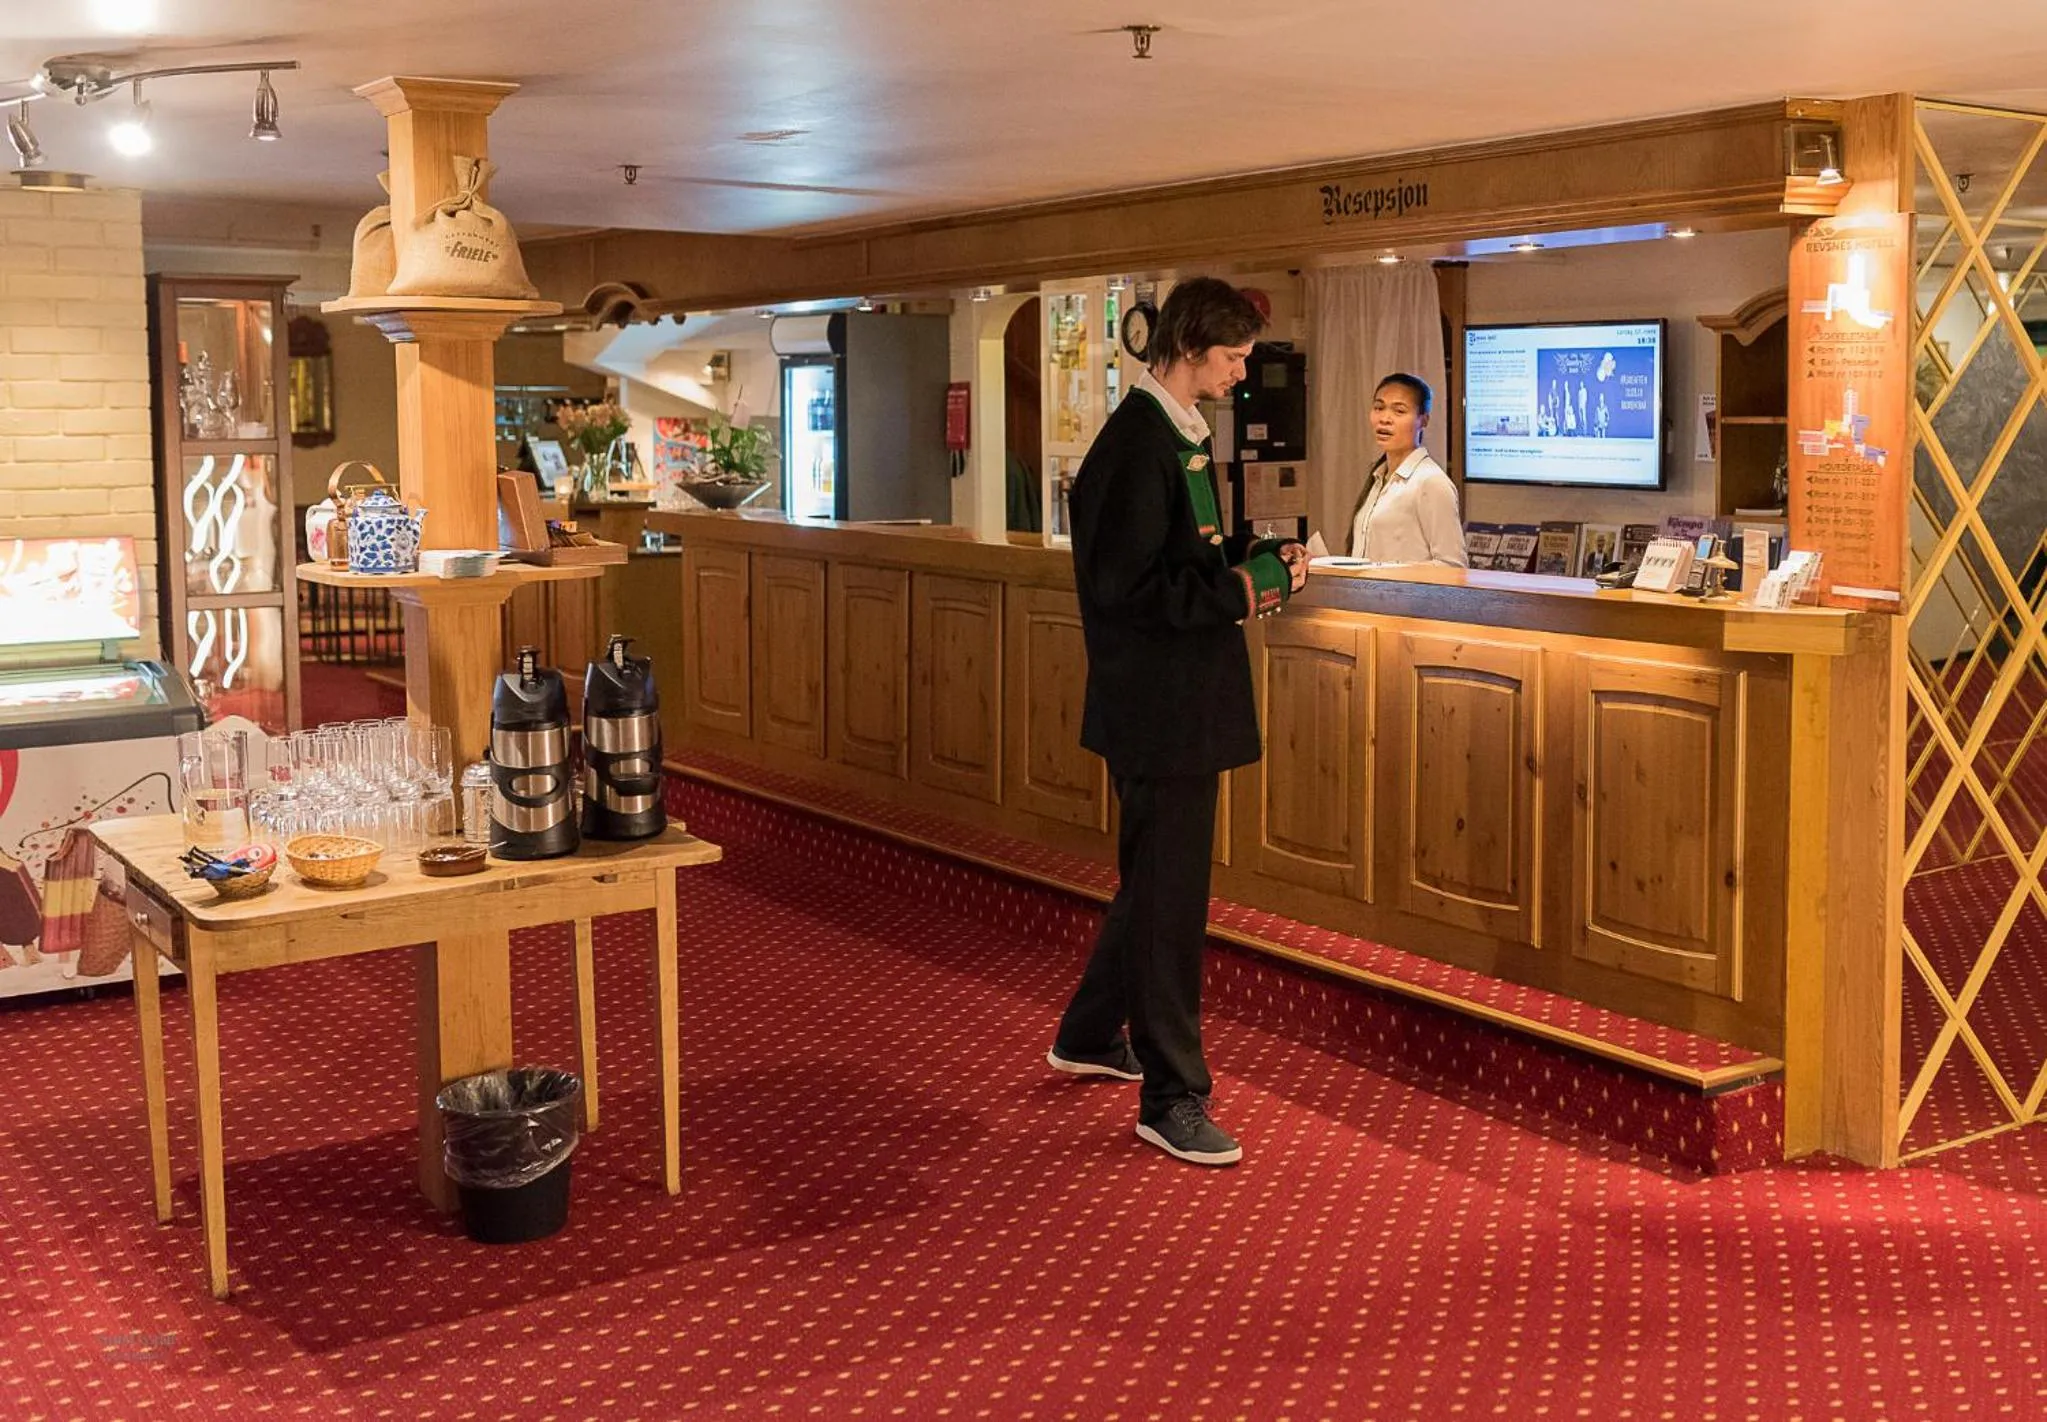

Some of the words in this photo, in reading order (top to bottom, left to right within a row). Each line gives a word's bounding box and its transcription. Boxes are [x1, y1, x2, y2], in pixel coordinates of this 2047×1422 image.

[1319, 178, 1428, 225] Resepsjon
[450, 240, 492, 263] FRIELE
[1806, 240, 1852, 253] REVSNES
